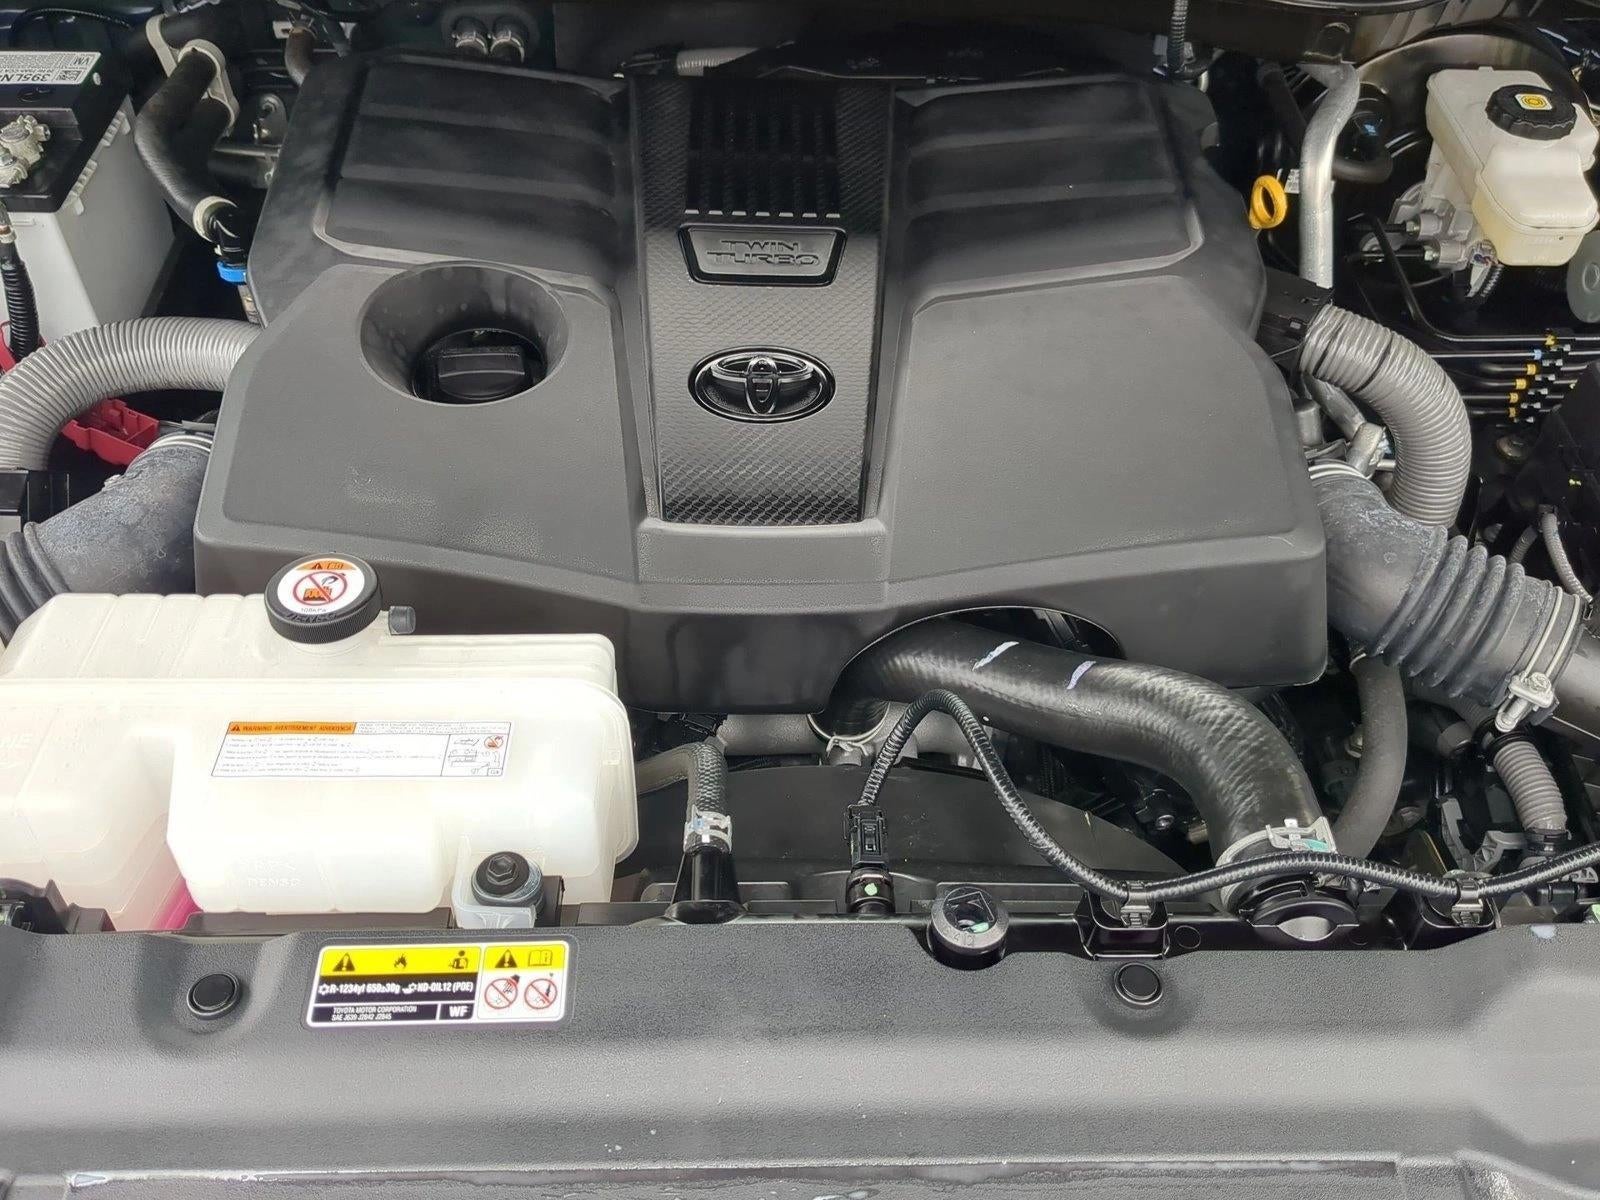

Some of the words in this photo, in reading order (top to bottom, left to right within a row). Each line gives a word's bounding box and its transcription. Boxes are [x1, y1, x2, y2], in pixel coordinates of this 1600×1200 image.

[721, 239, 799, 251] TWIN
[706, 251, 821, 265] TURBO
[329, 983, 366, 995] R-1234yf
[452, 981, 474, 993] (POE)
[333, 1006, 355, 1014] TOYOTA
[356, 1006, 377, 1014] MOTOR
[377, 1005, 417, 1014] CORPORATION
[448, 1005, 468, 1018] WF
